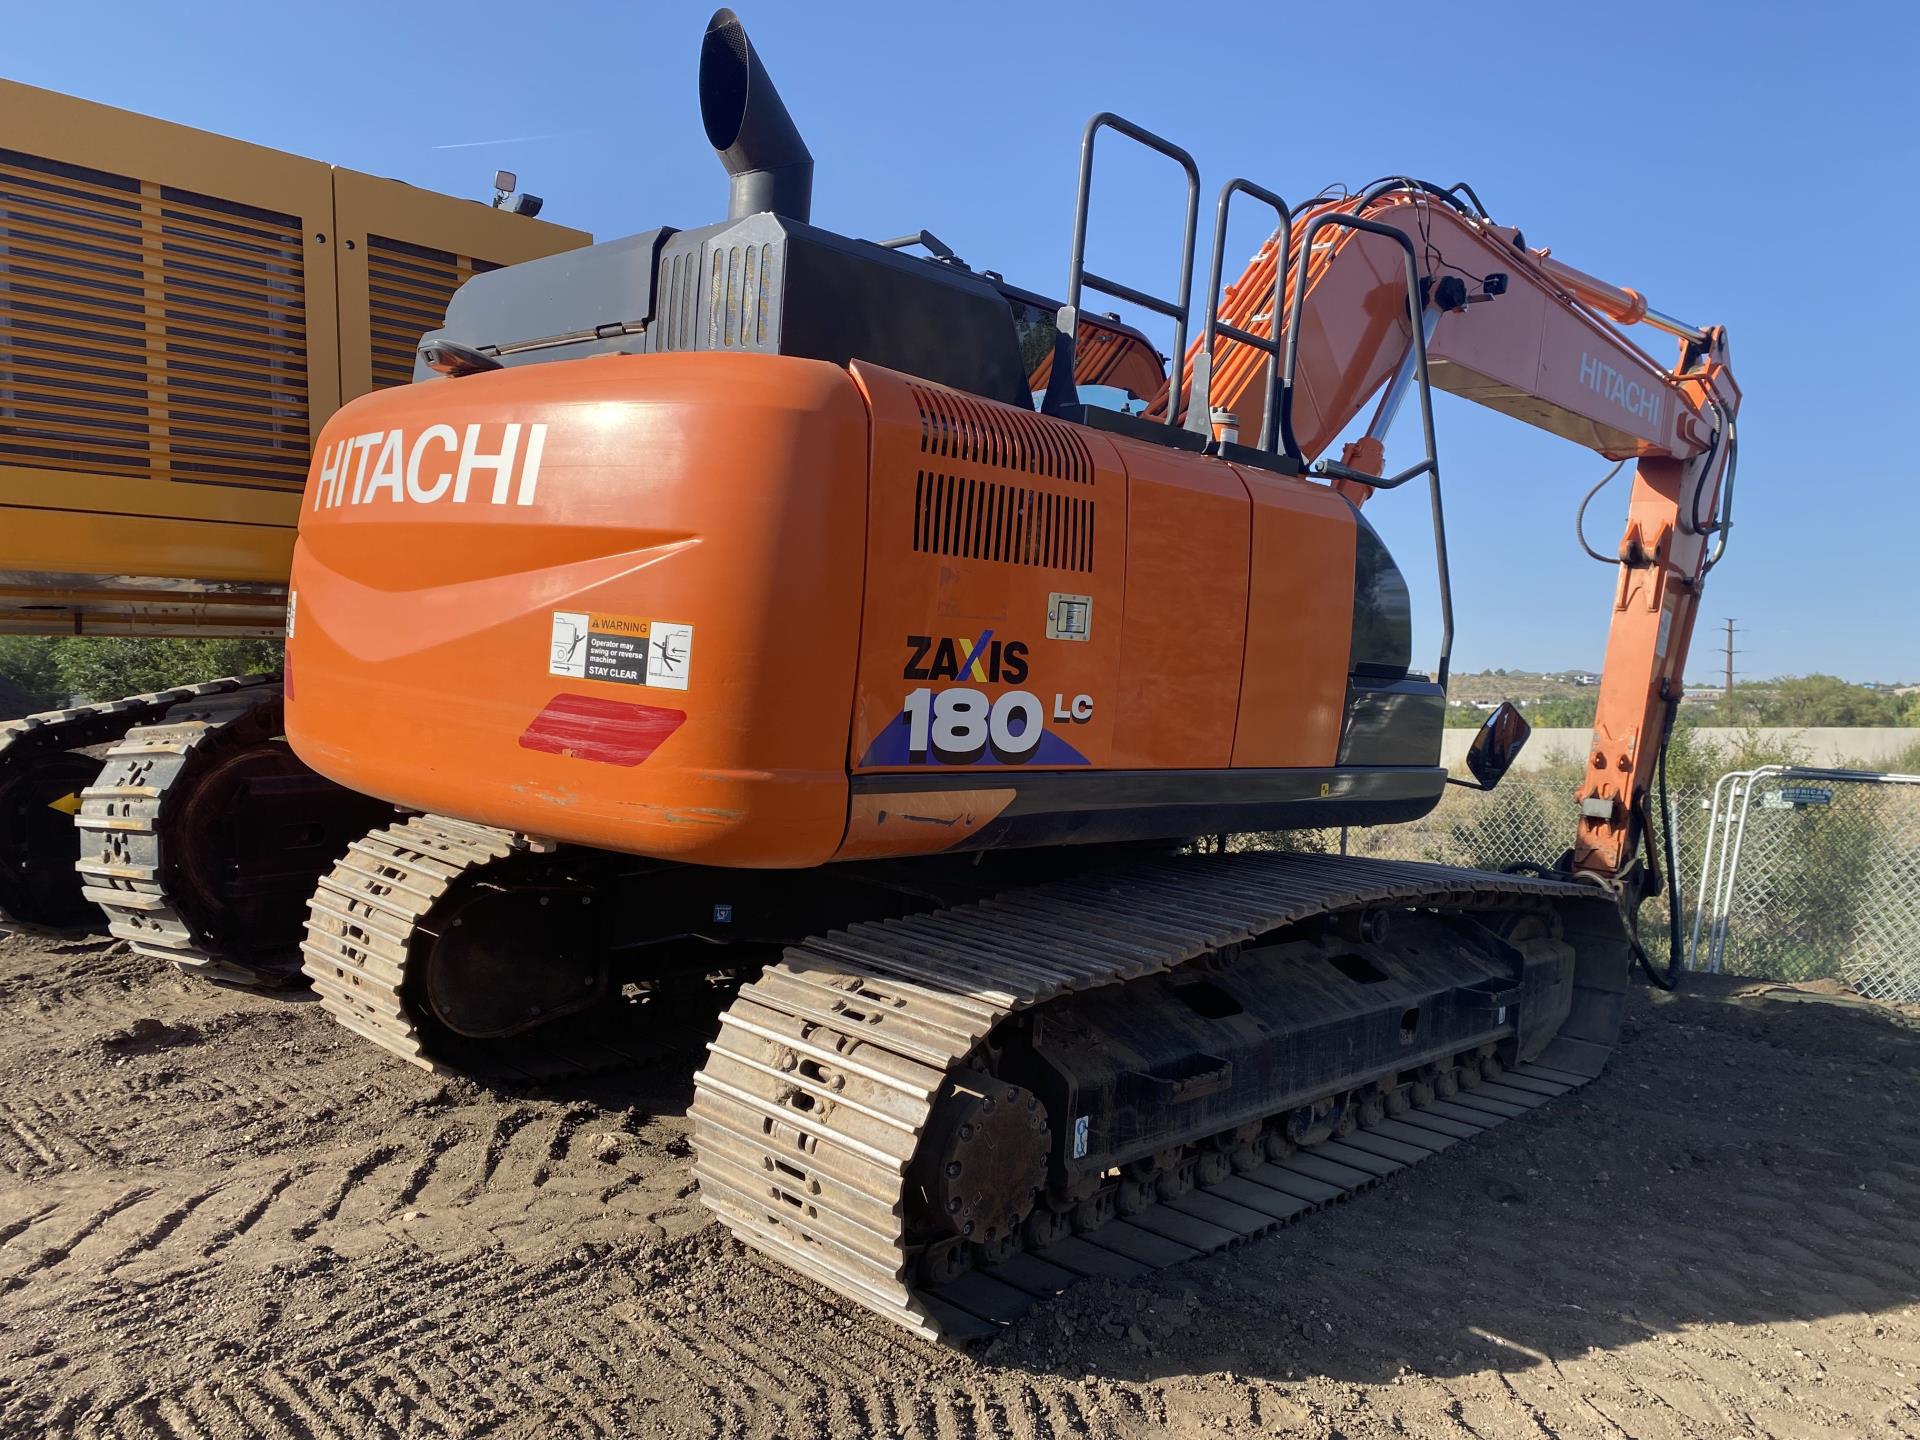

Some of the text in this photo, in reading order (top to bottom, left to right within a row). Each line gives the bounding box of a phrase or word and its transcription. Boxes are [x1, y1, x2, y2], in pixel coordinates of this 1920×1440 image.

[1579, 351, 1660, 425] HITACHI
[314, 424, 548, 512] HITACHI
[601, 619, 647, 633] WARNING
[591, 638, 619, 648] Operator
[589, 655, 617, 664] machine
[590, 647, 609, 656] swing
[618, 651, 643, 659] reverse
[903, 629, 1029, 684] ZAXIS
[588, 666, 637, 680] STAY CLEAR
[903, 687, 1094, 765] 180 LC
